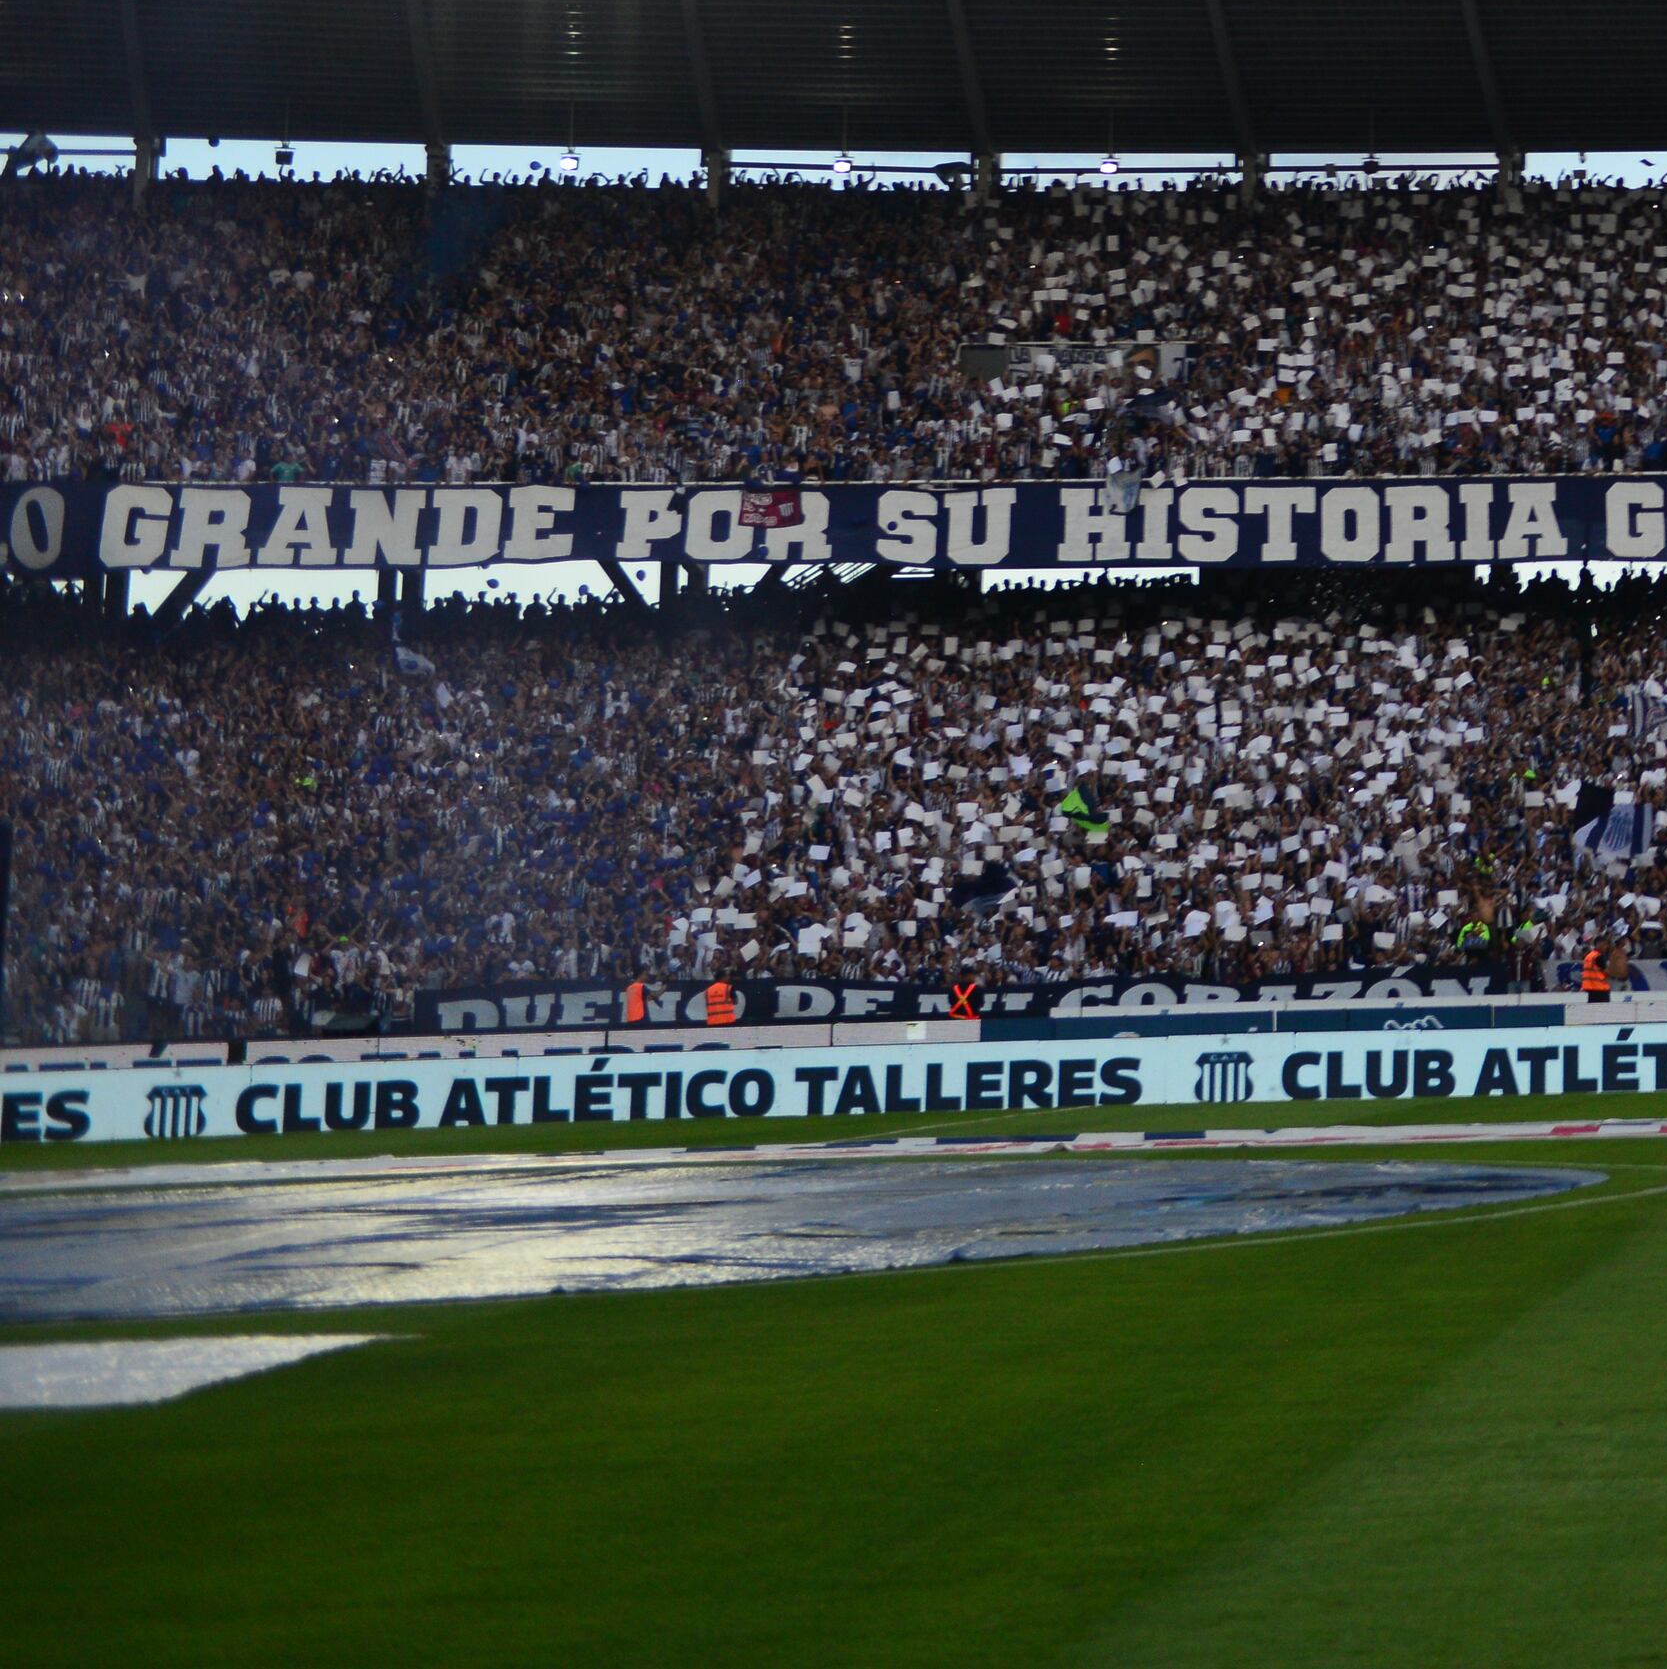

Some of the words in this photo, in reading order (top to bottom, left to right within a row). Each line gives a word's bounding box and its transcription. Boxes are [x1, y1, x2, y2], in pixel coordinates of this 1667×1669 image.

[100, 484, 576, 568] GRANDE
[616, 489, 833, 562] POR
[877, 487, 1016, 565] SU
[1057, 481, 1568, 563] HISTORIA
[775, 984, 895, 1018] DE
[235, 1078, 420, 1134] CLUB
[440, 1057, 776, 1128] ATLÉTICO
[795, 1056, 1142, 1116] TALLERES
[1281, 1048, 1456, 1099] CLUB
